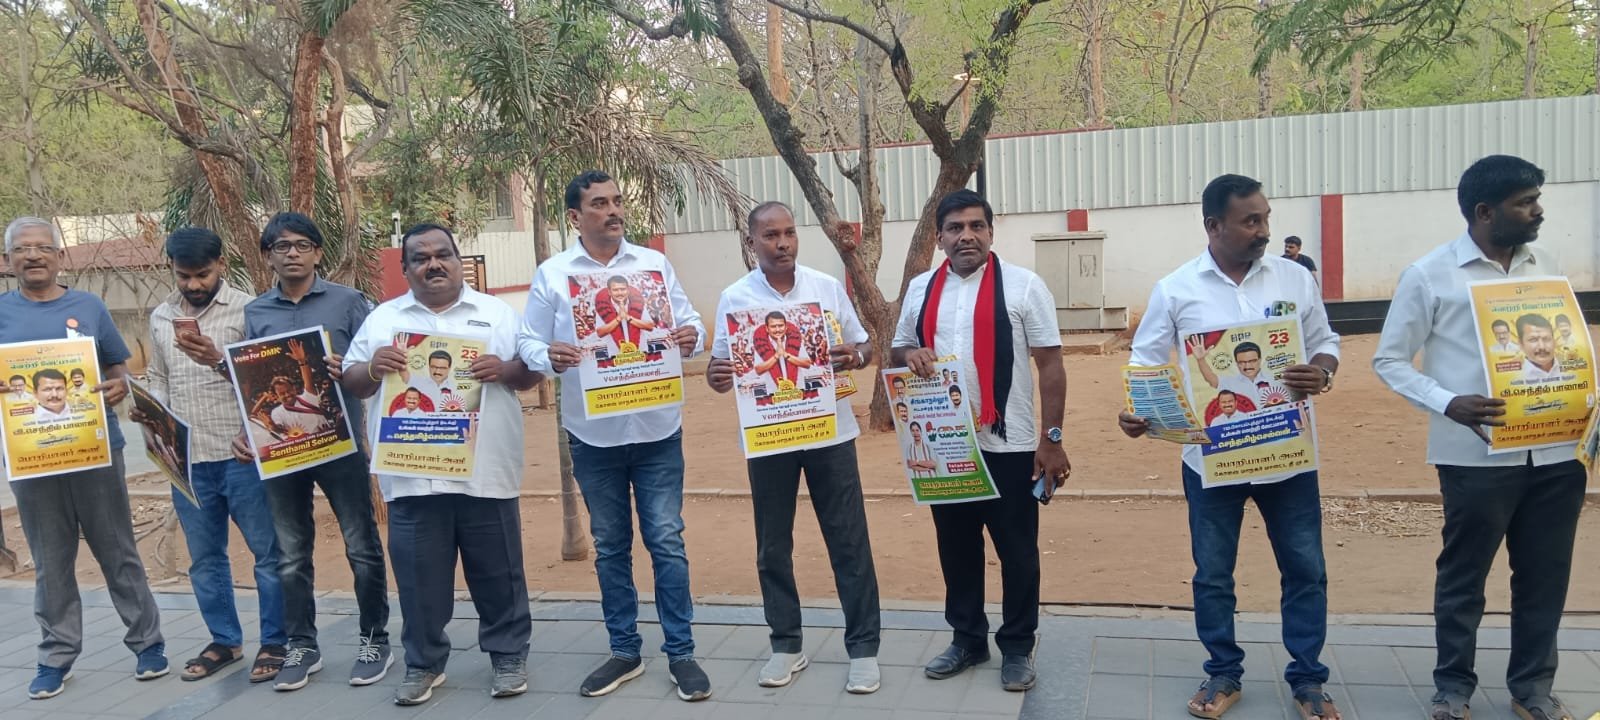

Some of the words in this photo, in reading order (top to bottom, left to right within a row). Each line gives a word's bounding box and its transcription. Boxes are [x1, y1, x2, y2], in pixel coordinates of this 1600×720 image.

[1270, 332, 1289, 344] 23
[250, 352, 260, 360] For
[260, 347, 282, 358] DMK
[462, 349, 478, 360] 23
[597, 386, 648, 400] பொறியாளர்
[650, 383, 671, 394] அணி
[1500, 385, 1550, 397] வி.செந்தில்
[1552, 381, 1588, 392] பாலாஜி
[63, 419, 98, 430] பாலாஜி
[756, 425, 805, 439] பொறியாளர்
[807, 421, 827, 431] அணி
[1500, 418, 1560, 432] பொறியாளர்
[1218, 429, 1290, 449] செந்தமிழ்செல்வன்
[1221, 430, 1242, 439] உங்கள்
[1243, 426, 1260, 436] வெற்றி
[18, 448, 75, 462] பொறியாளர்
[77, 445, 100, 455] அணி
[270, 442, 311, 458] Senthamil
[312, 434, 338, 447] Selvan
[387, 451, 440, 463] பொறியாளர்
[1216, 454, 1275, 469] பொறியாளர்
[1279, 450, 1305, 461] அணி
